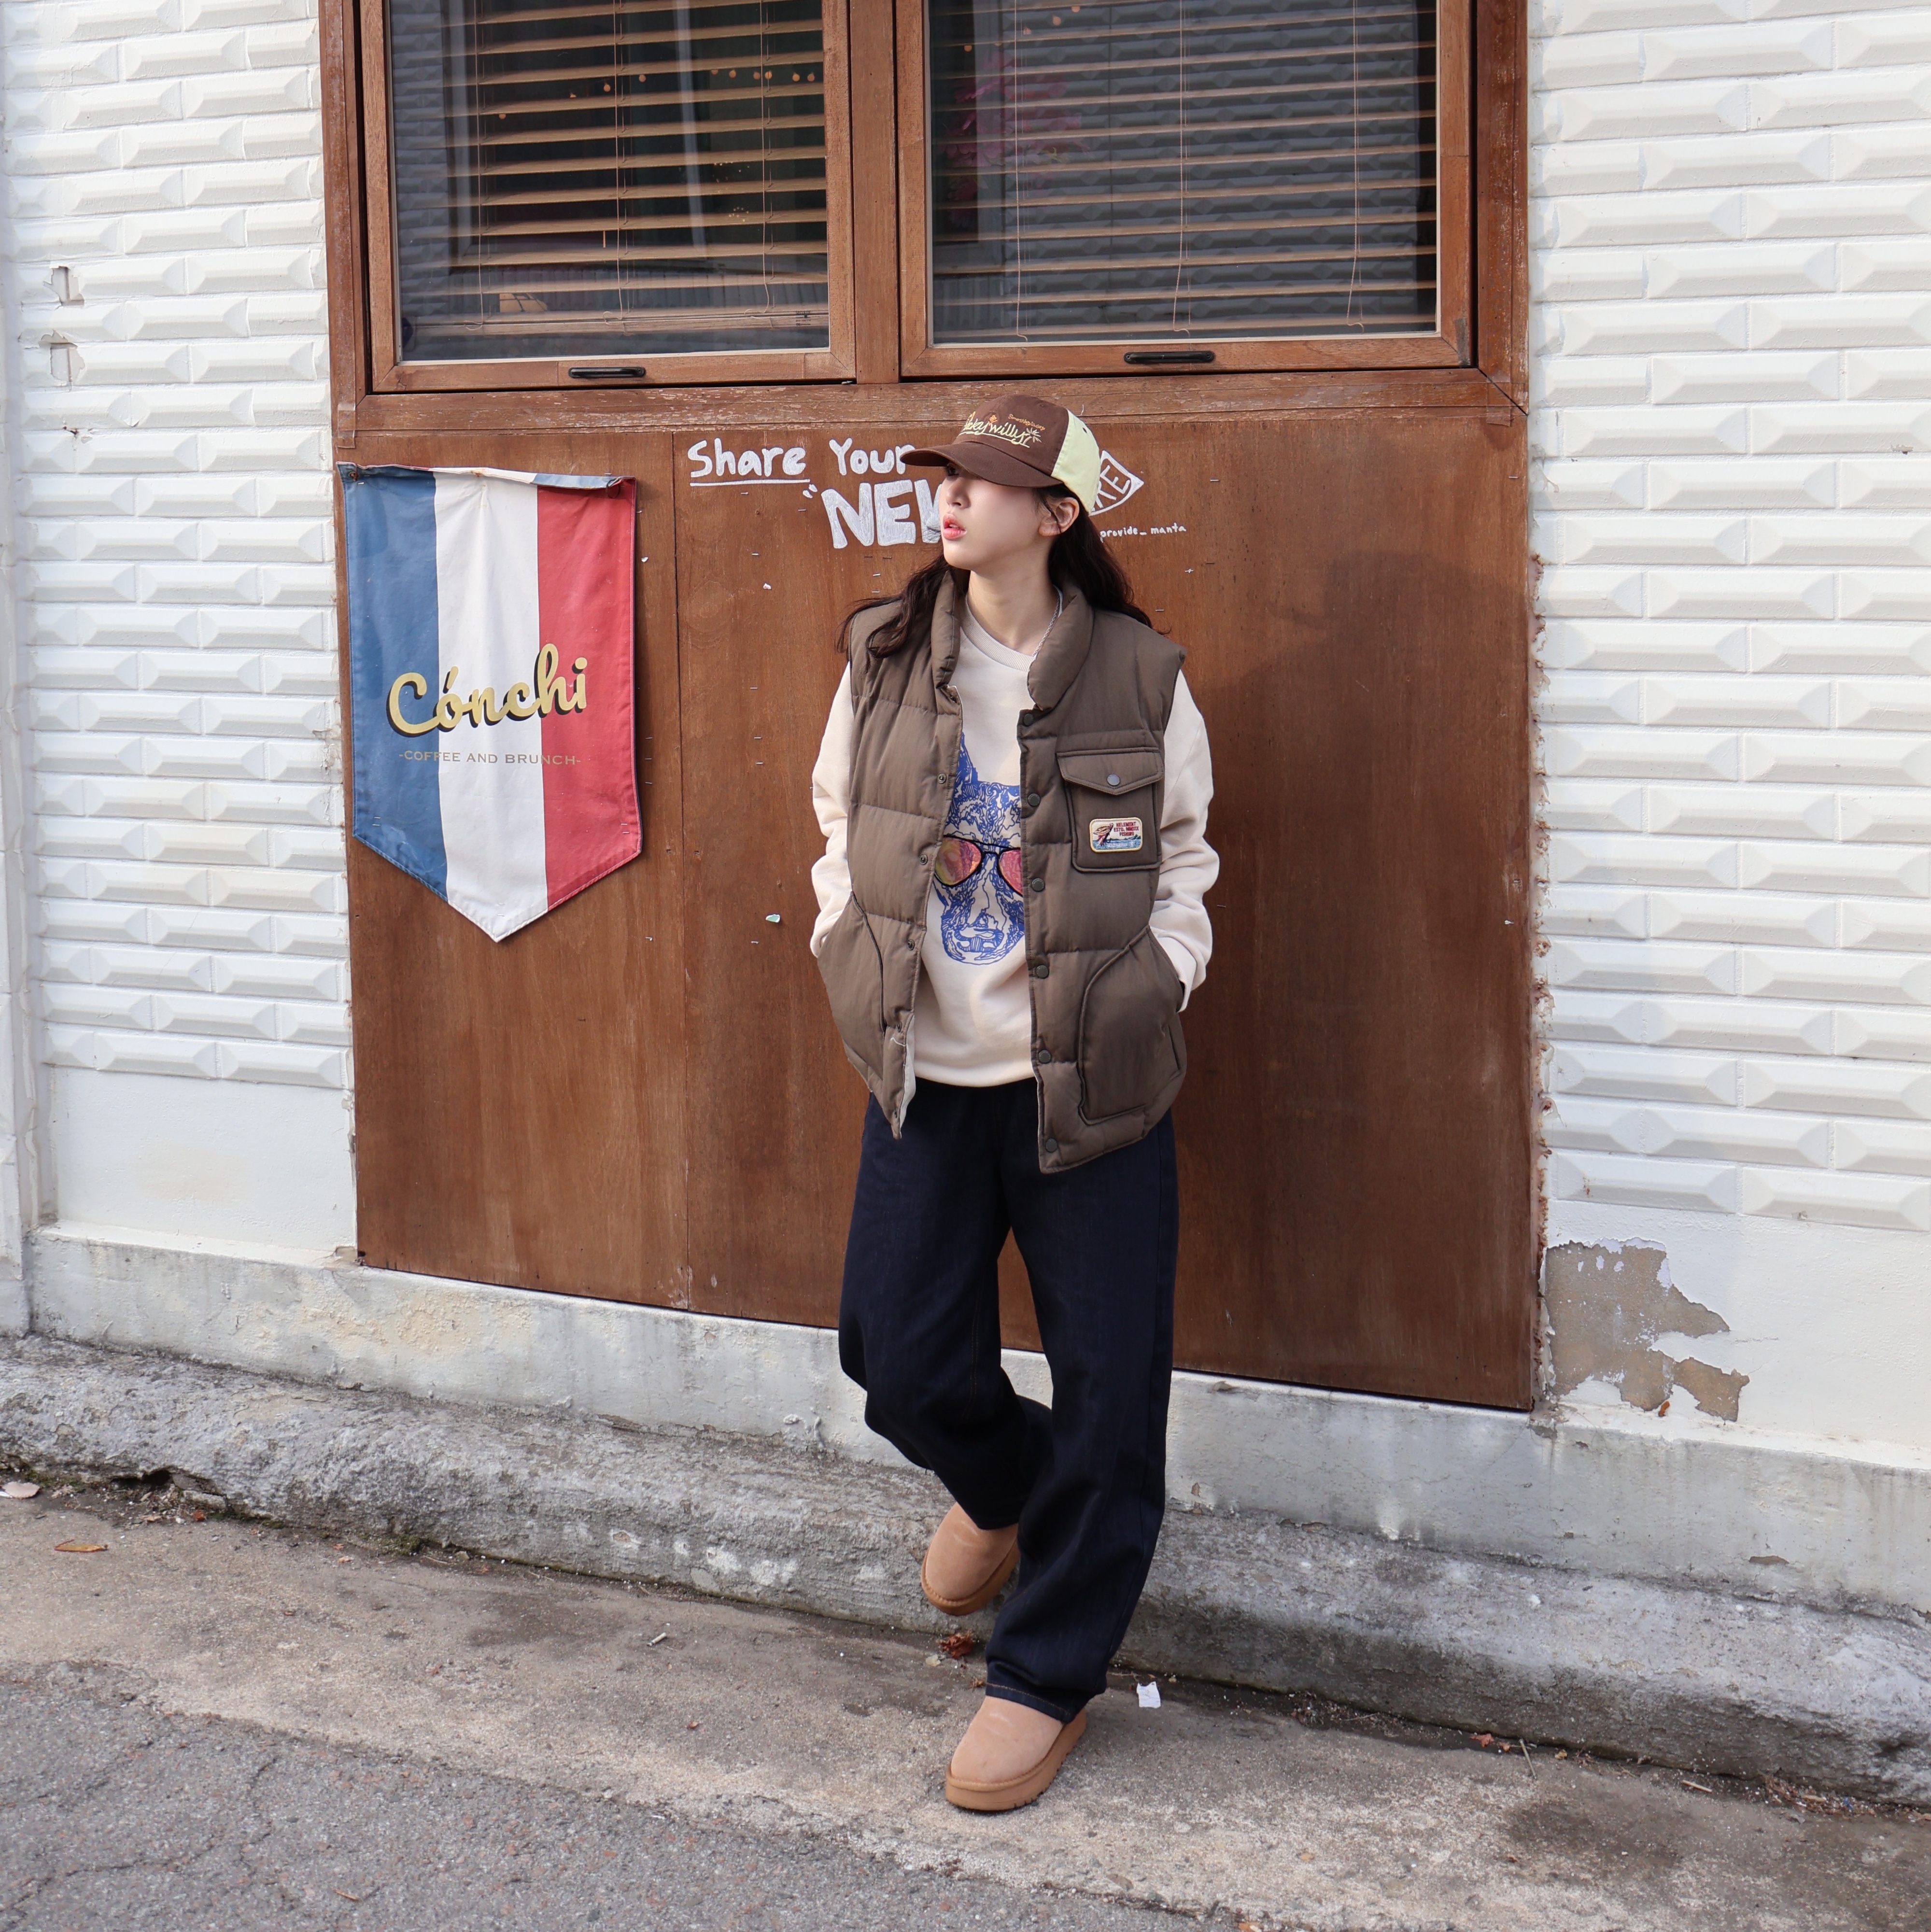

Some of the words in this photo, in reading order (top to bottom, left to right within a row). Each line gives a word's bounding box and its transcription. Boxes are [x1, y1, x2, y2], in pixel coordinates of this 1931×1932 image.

[687, 437, 806, 478] Share
[829, 437, 916, 476] Your
[386, 643, 588, 737] Cónchi
[466, 752, 498, 764] AND
